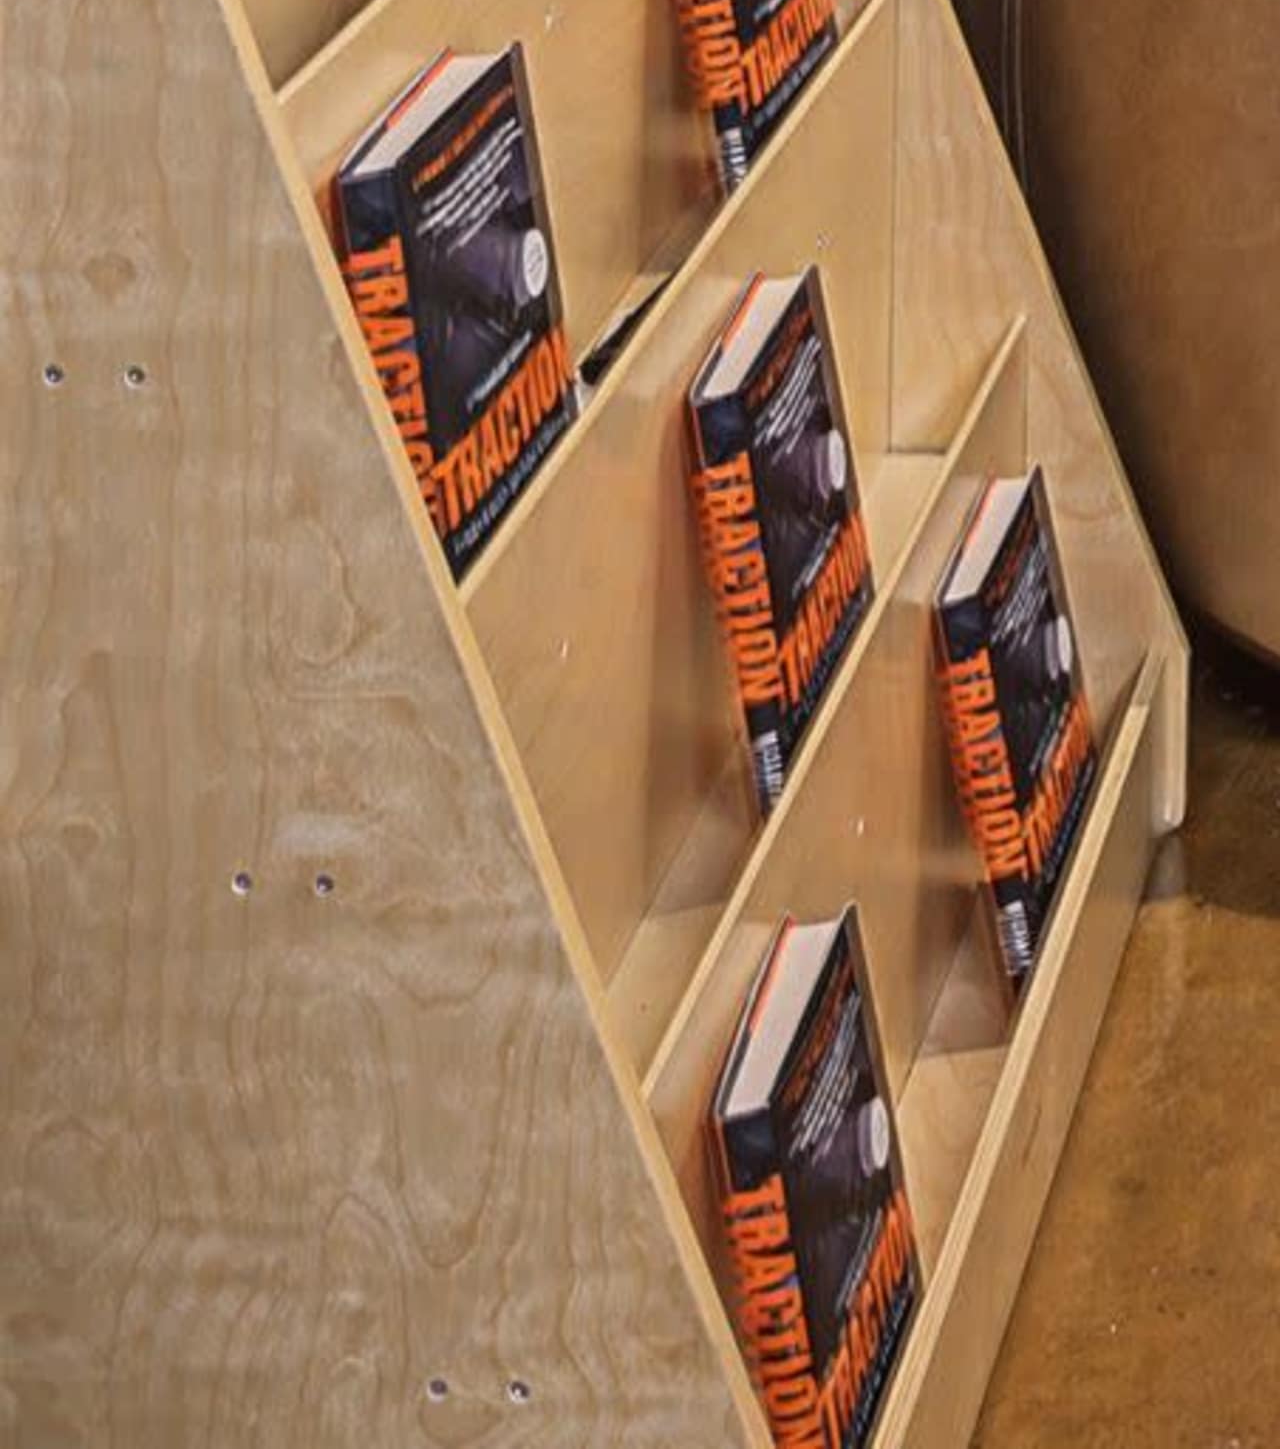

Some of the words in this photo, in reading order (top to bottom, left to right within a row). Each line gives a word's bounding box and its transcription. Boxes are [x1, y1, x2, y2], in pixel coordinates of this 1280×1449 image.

[433, 324, 575, 530] TRACTION
[703, 449, 782, 712] TRACTION
[778, 507, 873, 709] TRACTION
[948, 646, 1029, 884] TRACTION
